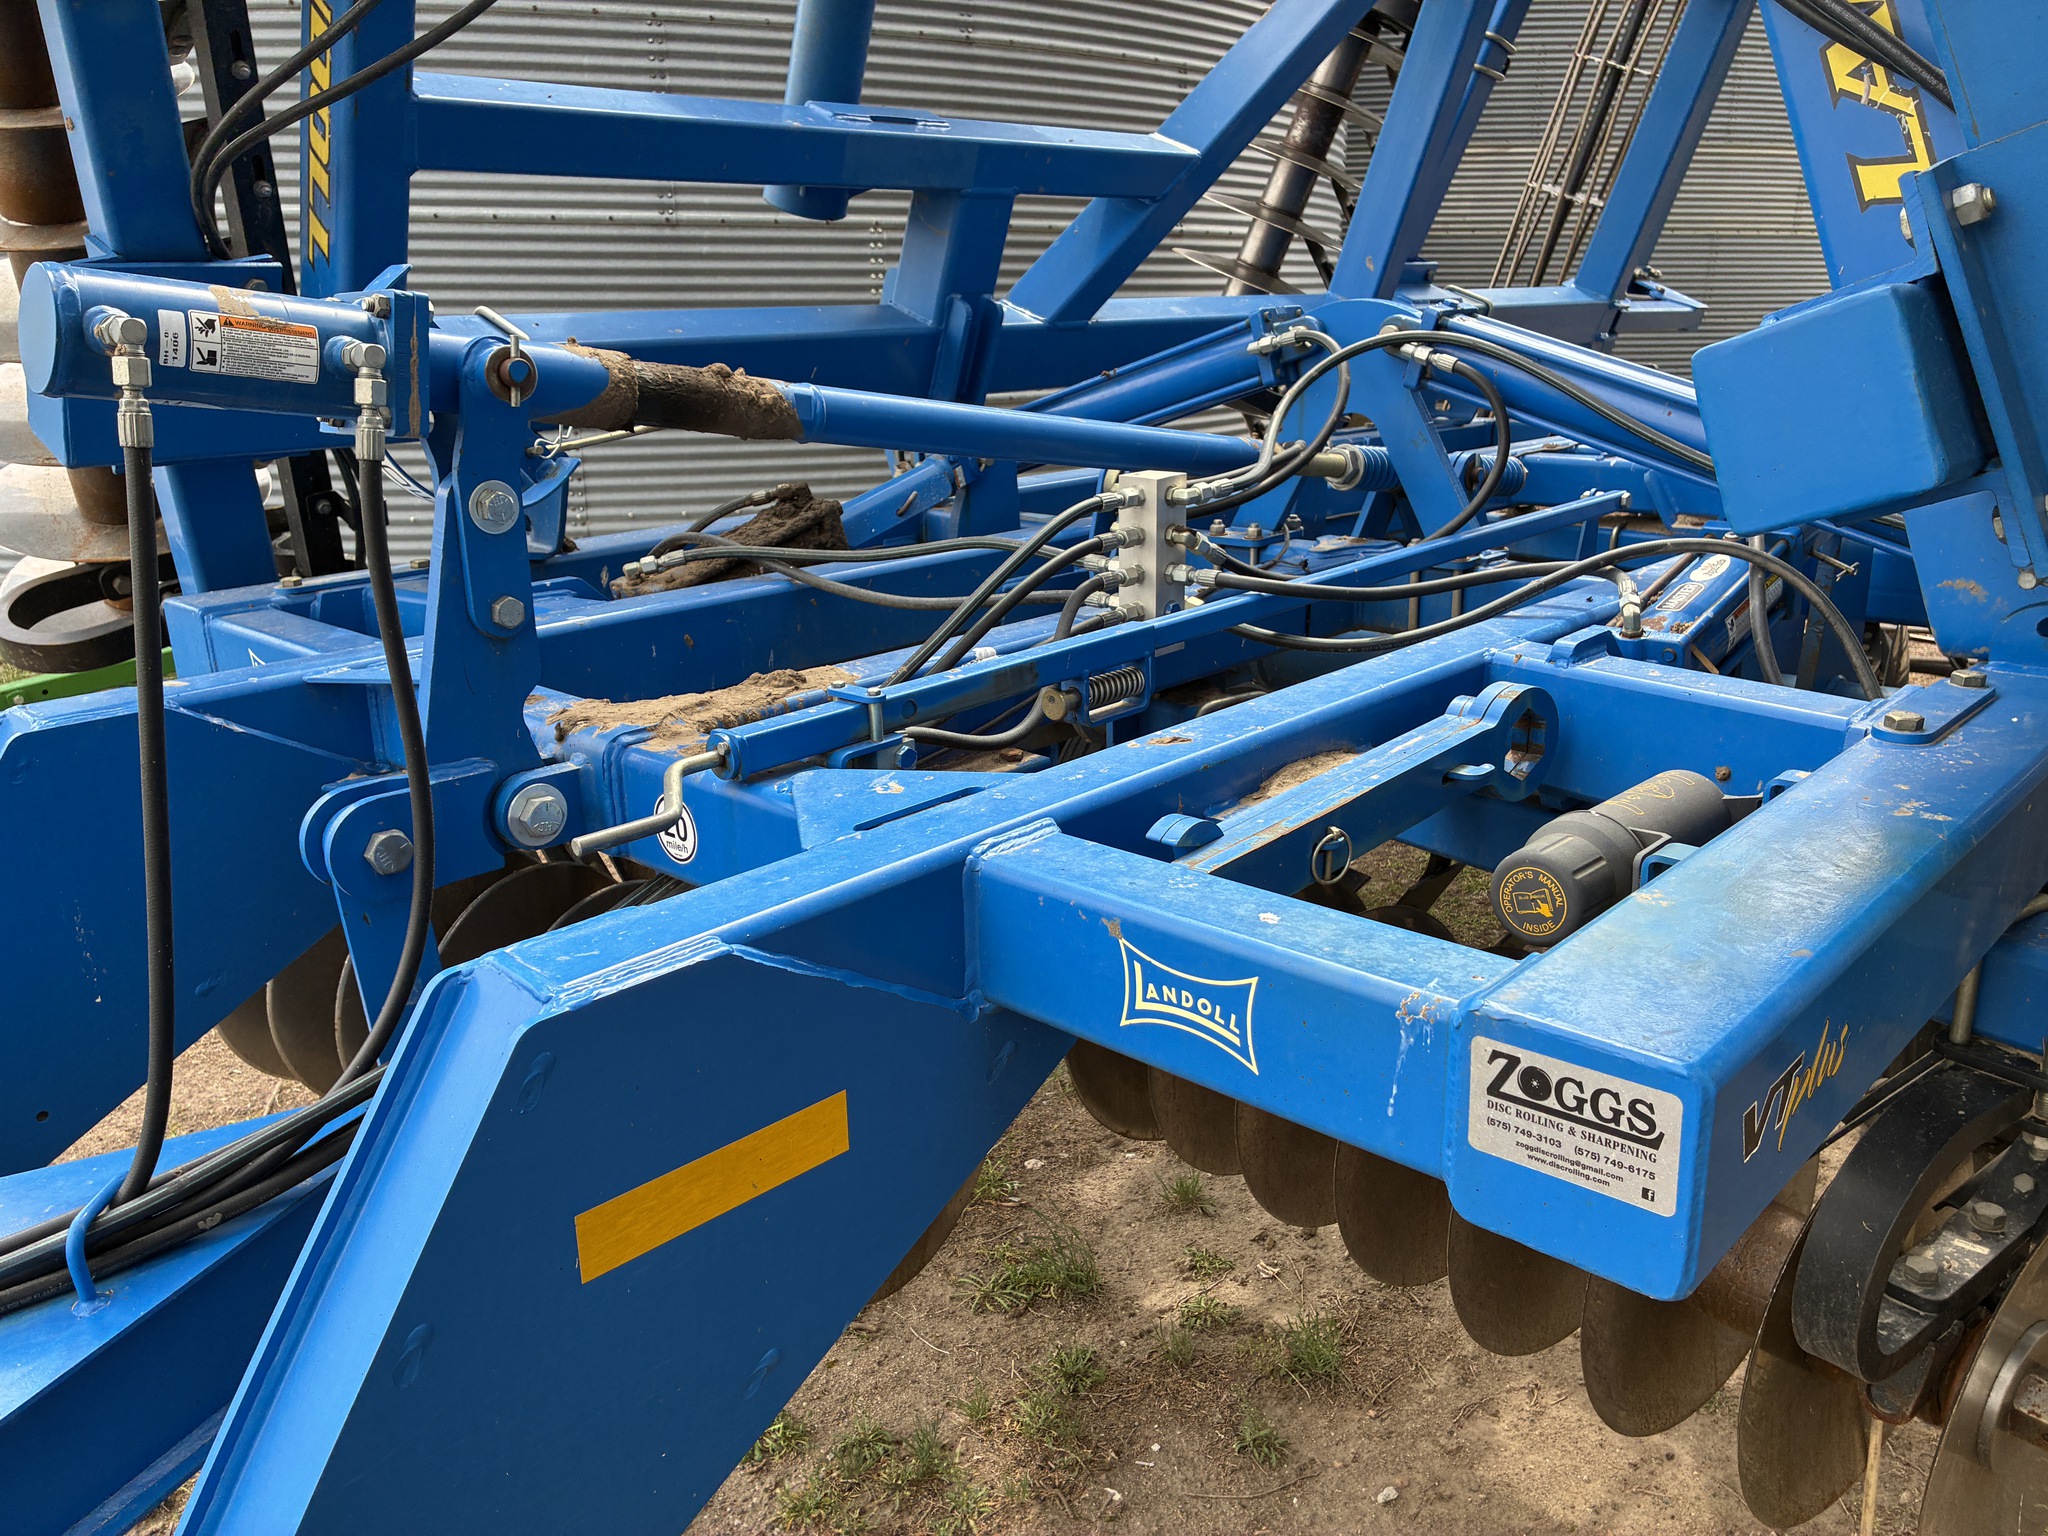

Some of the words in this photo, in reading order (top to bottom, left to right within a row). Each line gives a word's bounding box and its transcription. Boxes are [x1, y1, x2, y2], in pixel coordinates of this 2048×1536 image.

[1660, 584, 1699, 610] MASTER
[666, 840, 689, 853] mile/h
[1502, 871, 1534, 913] OPERATOR'S
[1538, 873, 1564, 908] MANUAL
[1522, 919, 1556, 933] INSIDE
[1133, 959, 1241, 1048] LANDOLL
[1486, 1049, 1661, 1142] ZOGGS
[1486, 1099, 1513, 1116] DISC
[1515, 1109, 1564, 1133] ROLLING
[1568, 1126, 1577, 1137] &
[1580, 1130, 1658, 1164] SHARPENING
[1486, 1116, 1511, 1133] (575)
[1514, 1125, 1562, 1149] 749-3103
[1574, 1145, 1601, 1163] (575)
[1603, 1156, 1656, 1181] 749-6175
[1515, 1140, 1624, 1183] zoggdiscrolling@gmail.com
[1527, 1154, 1611, 1187] www.discrolling.com
